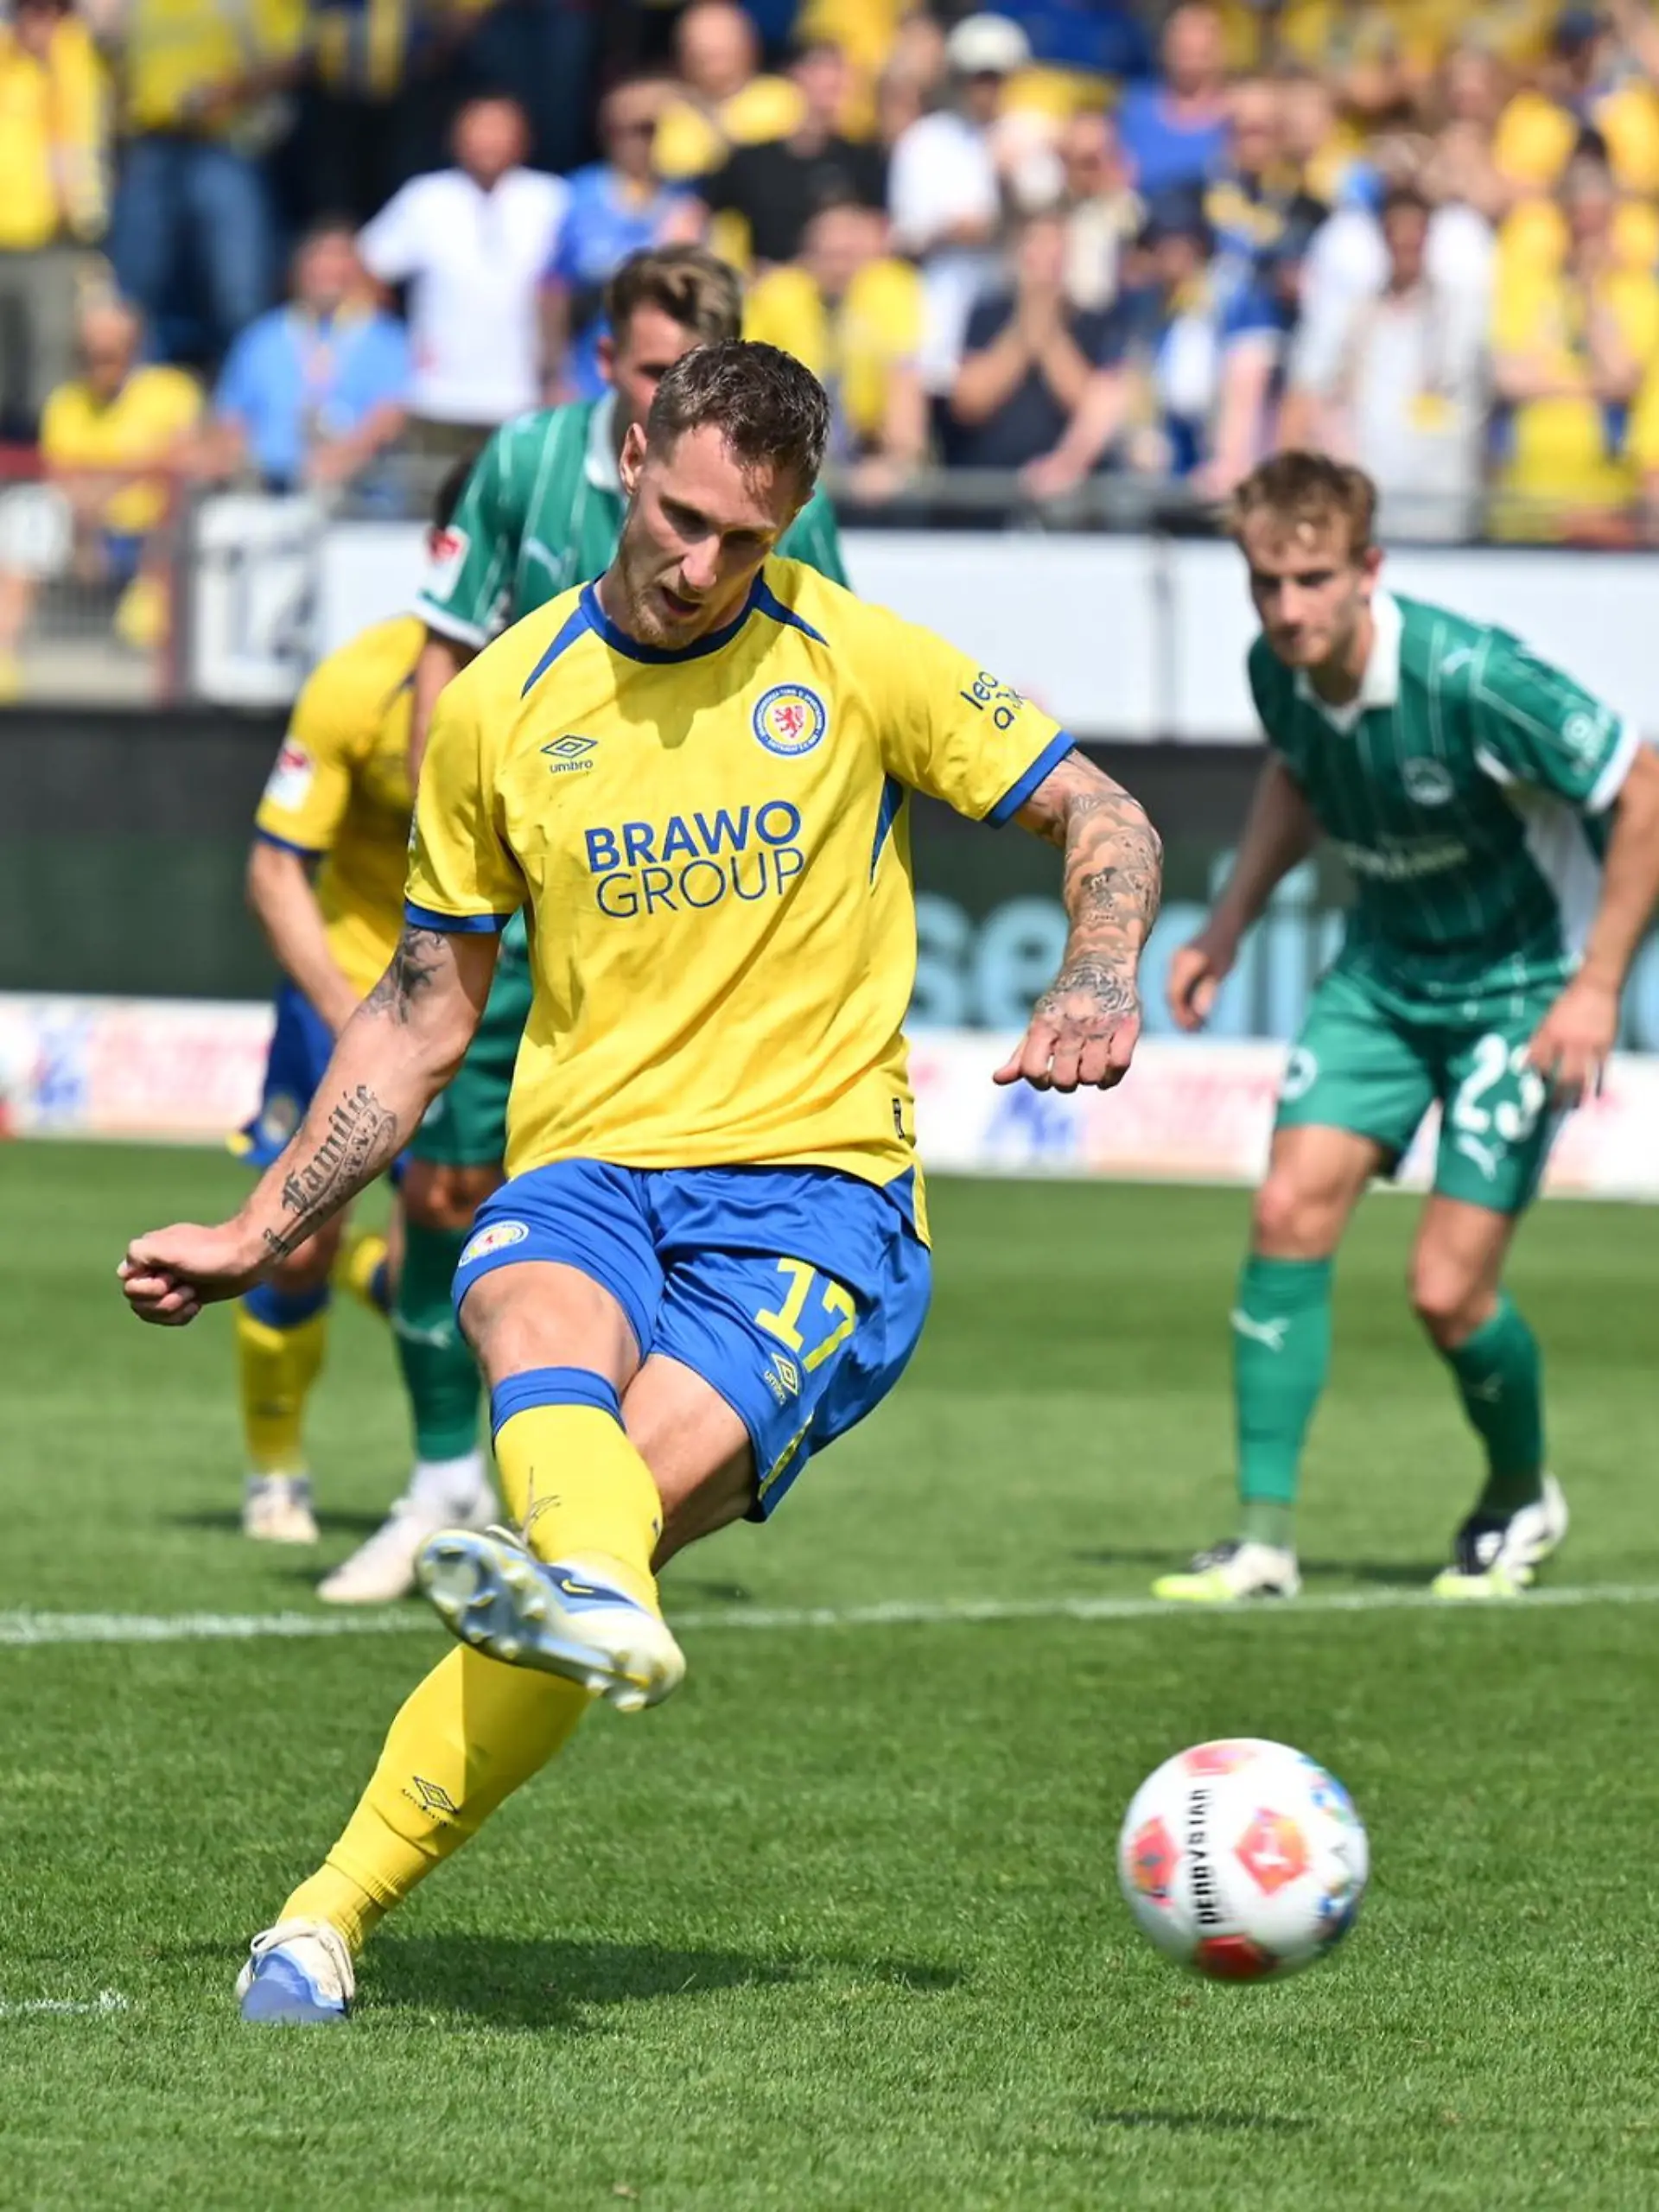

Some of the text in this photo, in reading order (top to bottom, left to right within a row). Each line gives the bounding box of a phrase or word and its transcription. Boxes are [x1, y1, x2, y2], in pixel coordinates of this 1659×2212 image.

[550, 760, 594, 774] umbro
[584, 800, 802, 873] BRAWO
[596, 847, 804, 918] GROUP
[282, 1084, 372, 1215] Familie
[753, 1257, 856, 1373] 17
